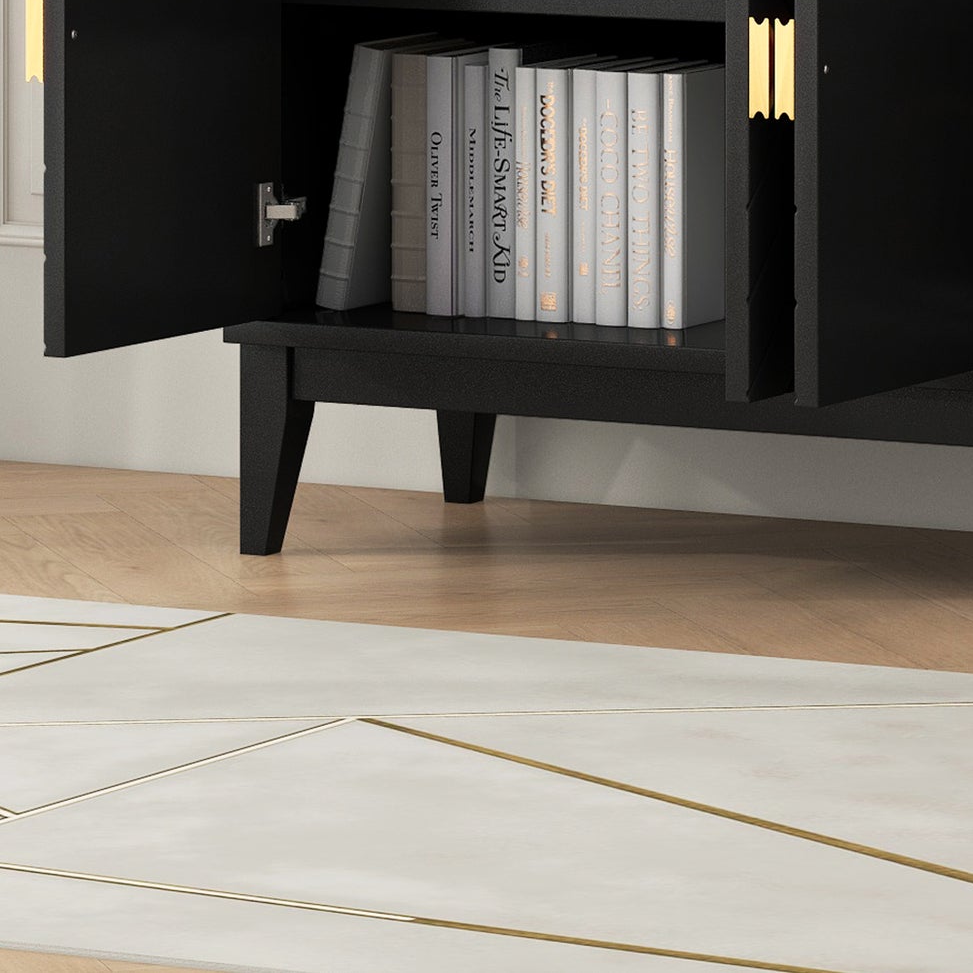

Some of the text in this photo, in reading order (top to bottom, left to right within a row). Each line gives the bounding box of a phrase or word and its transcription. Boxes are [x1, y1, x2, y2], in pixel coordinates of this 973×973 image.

[494, 68, 510, 102] The
[631, 108, 649, 135] BE
[430, 132, 444, 240] OLIVER TWIST
[468, 128, 477, 253] MIDDLEMARCH
[631, 141, 650, 203] TWO
[540, 180, 557, 215] DIET
[578, 186, 588, 211] DIET
[600, 192, 621, 295] CHANEL
